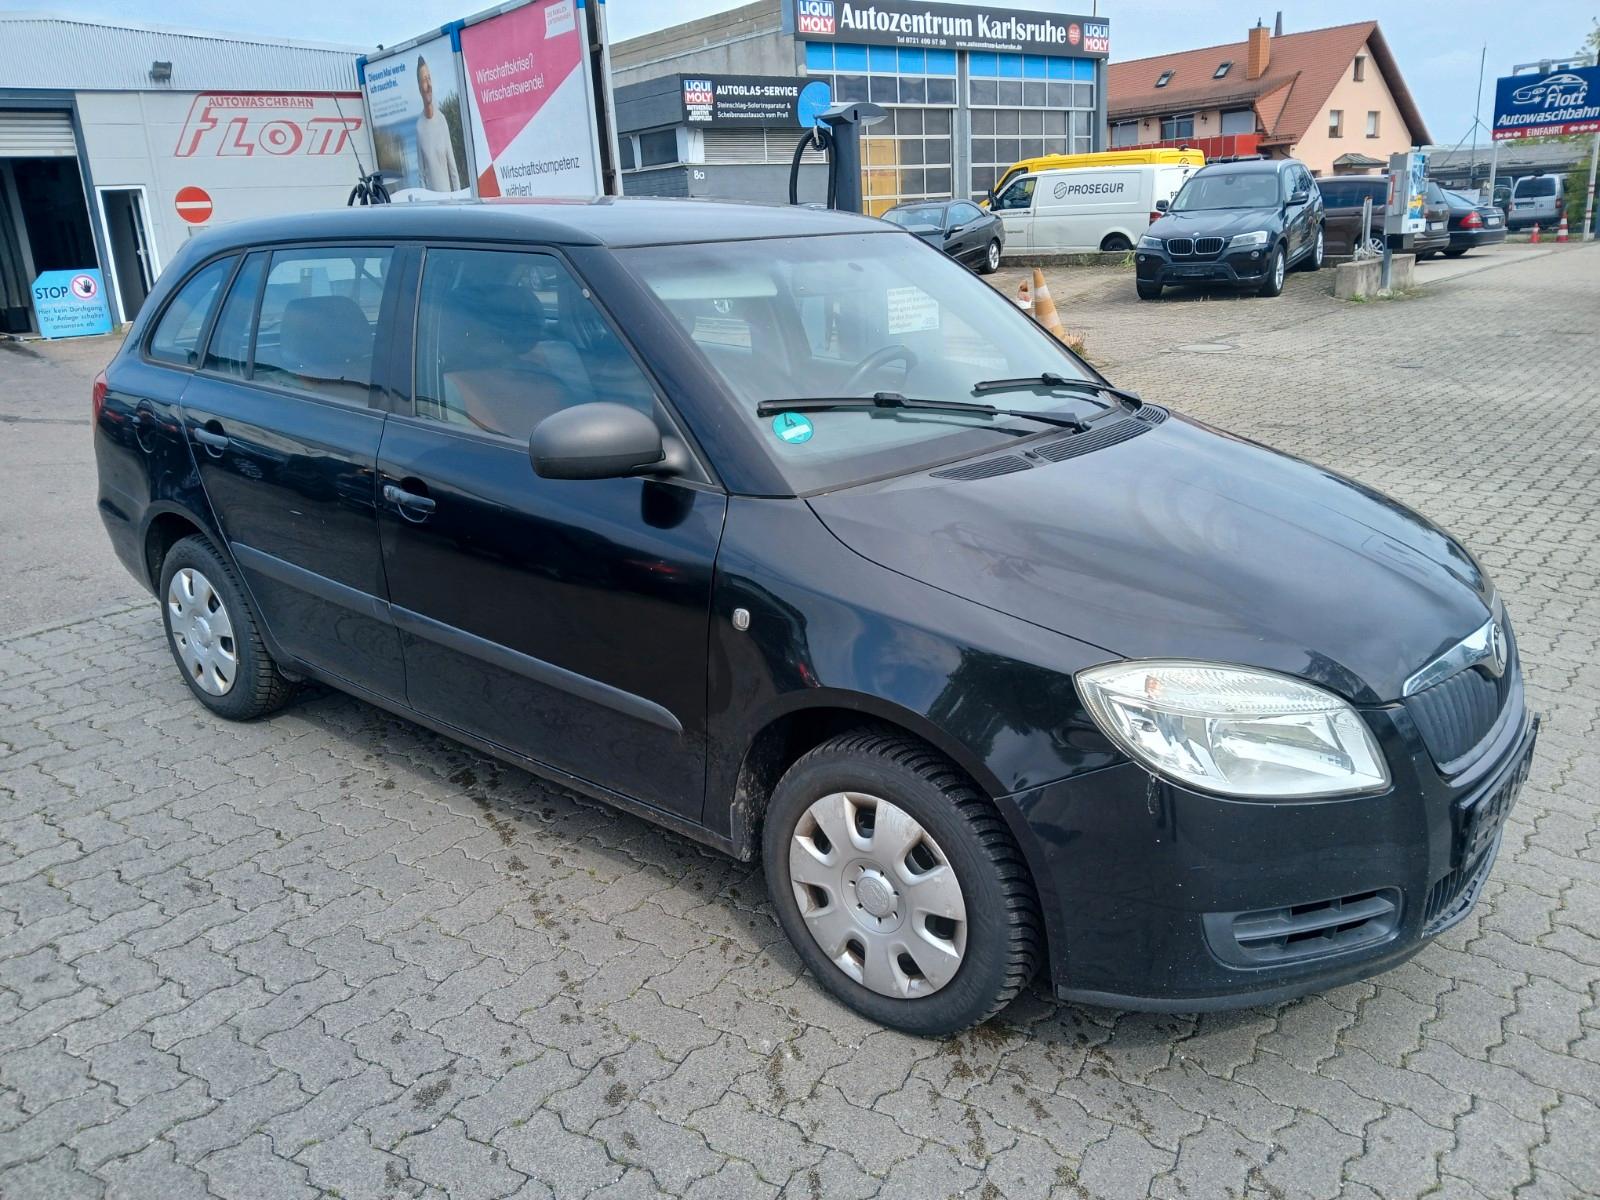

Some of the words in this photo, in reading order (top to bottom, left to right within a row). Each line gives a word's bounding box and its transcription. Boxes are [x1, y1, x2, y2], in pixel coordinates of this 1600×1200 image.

[800, 0, 833, 16] LIQUI
[800, 16, 834, 32] MOLY
[840, 3, 972, 37] Autozentrum
[977, 14, 1066, 44] Karlsruhe
[1085, 24, 1109, 38] LIQUI
[1085, 38, 1109, 51] MOLY
[475, 52, 534, 85] Wirtschaftskrise?
[480, 73, 545, 104] Wirtschaftswende!
[685, 81, 712, 91] LIQUI
[716, 85, 798, 97] AUTOGLAS-SERVICE
[208, 96, 314, 108] AUTOWASCHBAHN
[686, 92, 713, 102] MOLY
[1544, 91, 1587, 109] Flott
[1497, 105, 1600, 126] Autowaschbahn
[174, 97, 363, 158] FLOTT
[1526, 125, 1564, 137] EINFAHRT
[500, 156, 580, 180] Wirtschaftskompetenz
[505, 181, 533, 197] wählen!
[1067, 182, 1124, 196] PROSEGUR
[35, 286, 68, 300] STOP
